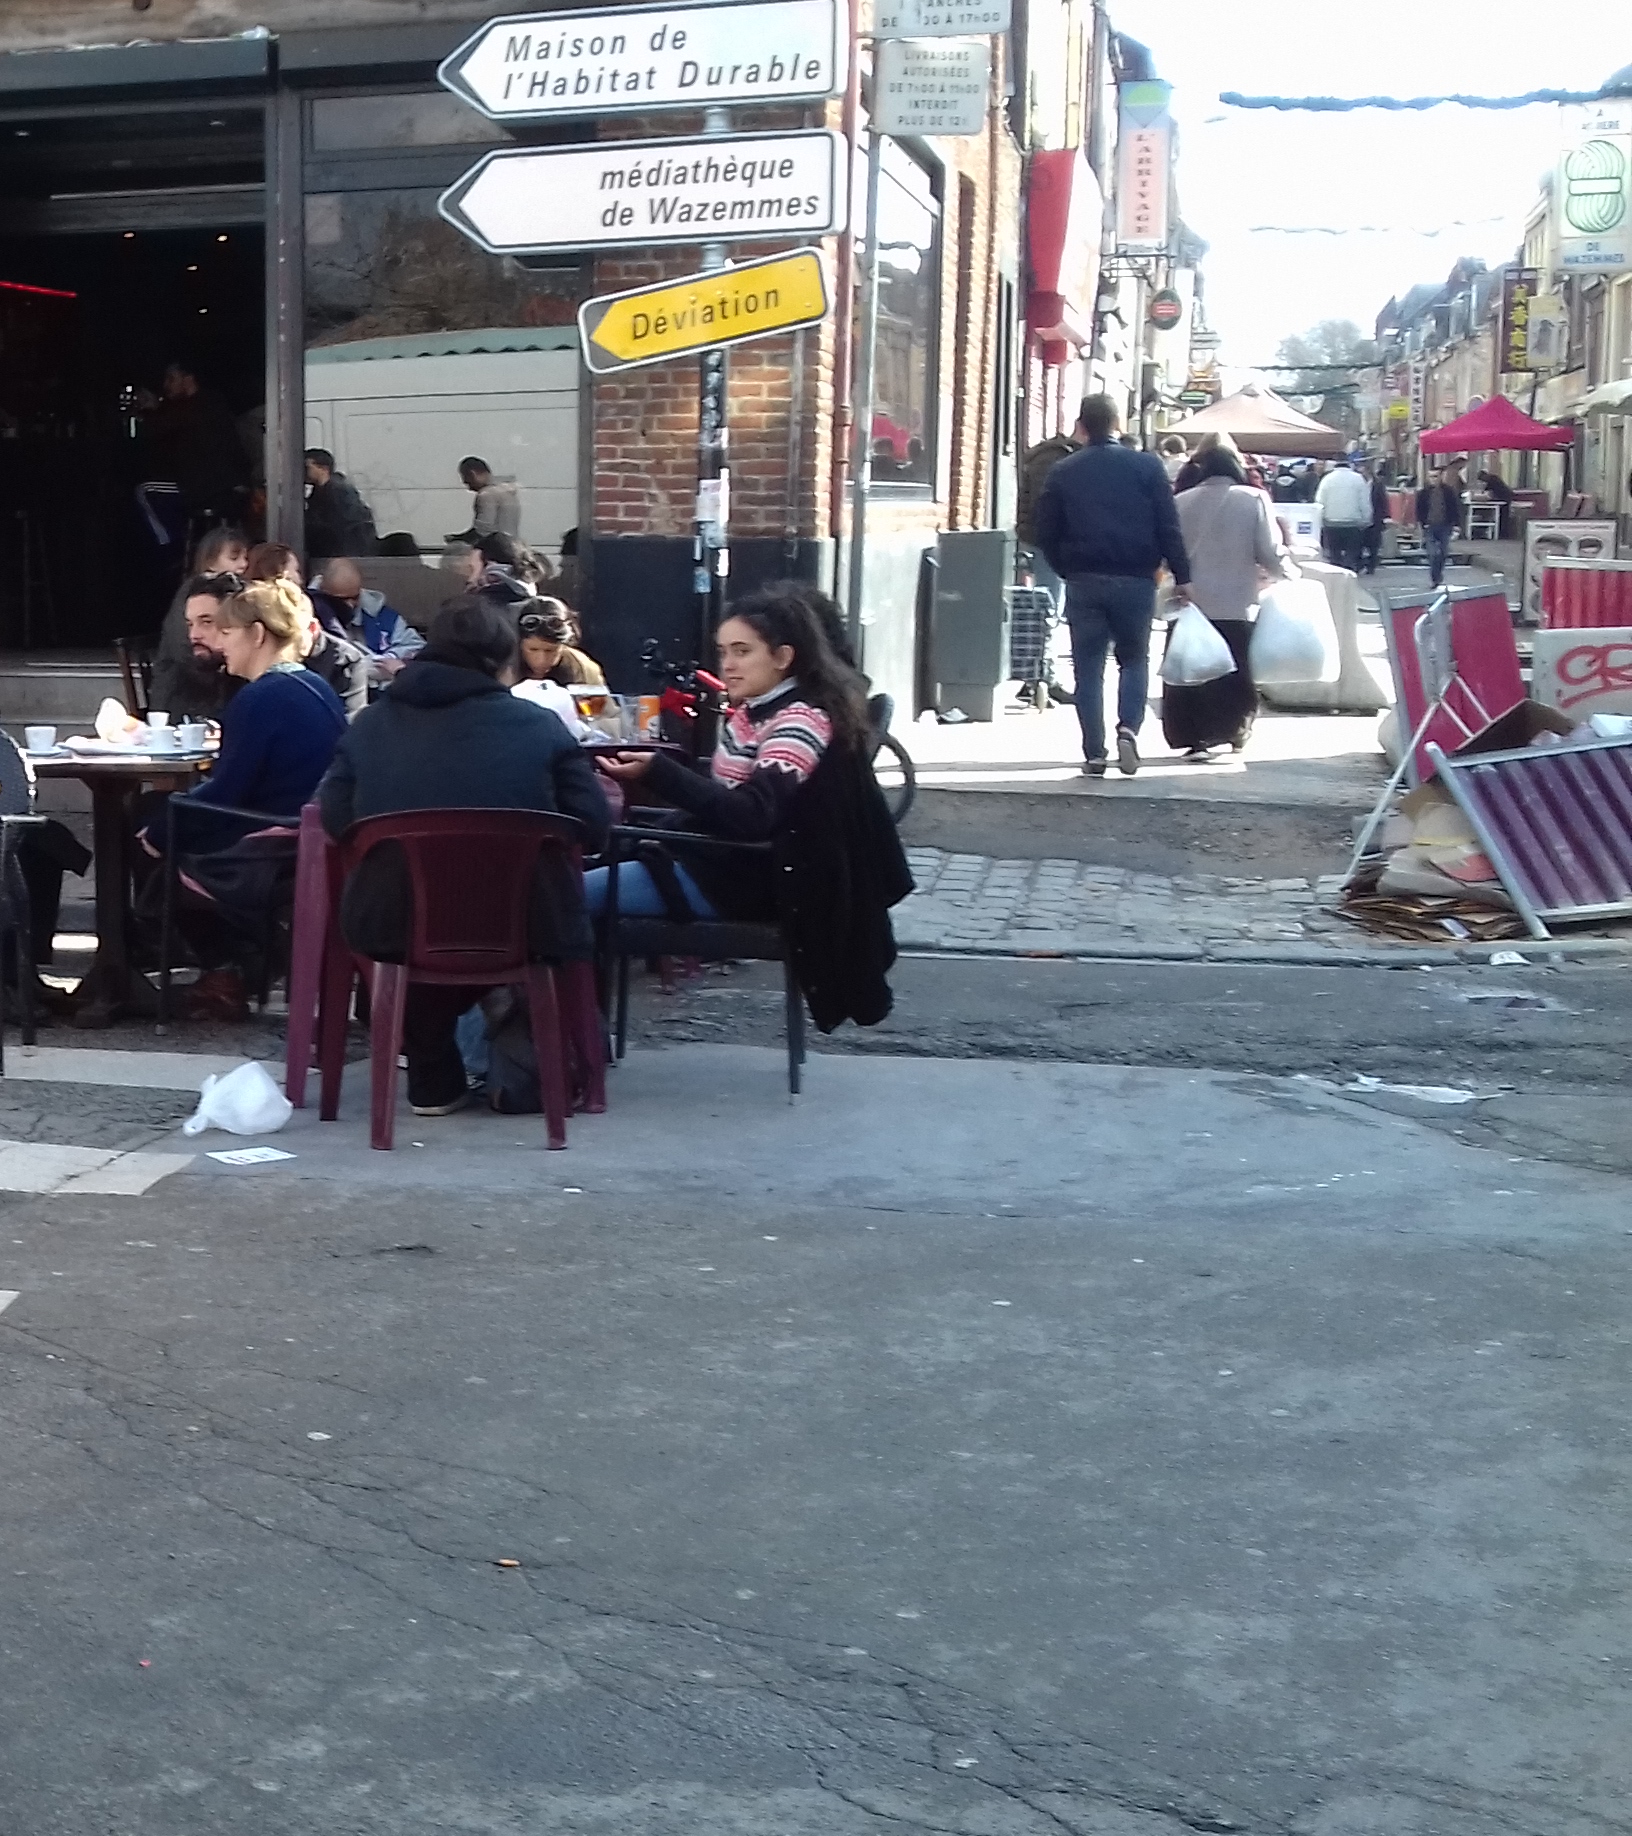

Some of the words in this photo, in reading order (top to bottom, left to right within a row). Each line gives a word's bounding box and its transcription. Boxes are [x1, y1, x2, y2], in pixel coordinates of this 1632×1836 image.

[881, 17, 898, 28] DE
[503, 32, 627, 63] Maison
[649, 25, 688, 53] de
[904, 51, 969, 61] LIVRAISONS
[503, 62, 657, 99] l'Habitat
[678, 54, 822, 88] Durable
[889, 83, 904, 93] DE
[908, 100, 959, 110] INTERDIT
[898, 116, 925, 126] PLUS
[929, 116, 944, 126] DE
[599, 155, 795, 191] médiathèque
[600, 201, 634, 228] de
[648, 193, 820, 226] Wazemmes
[630, 287, 782, 342] Déviation
